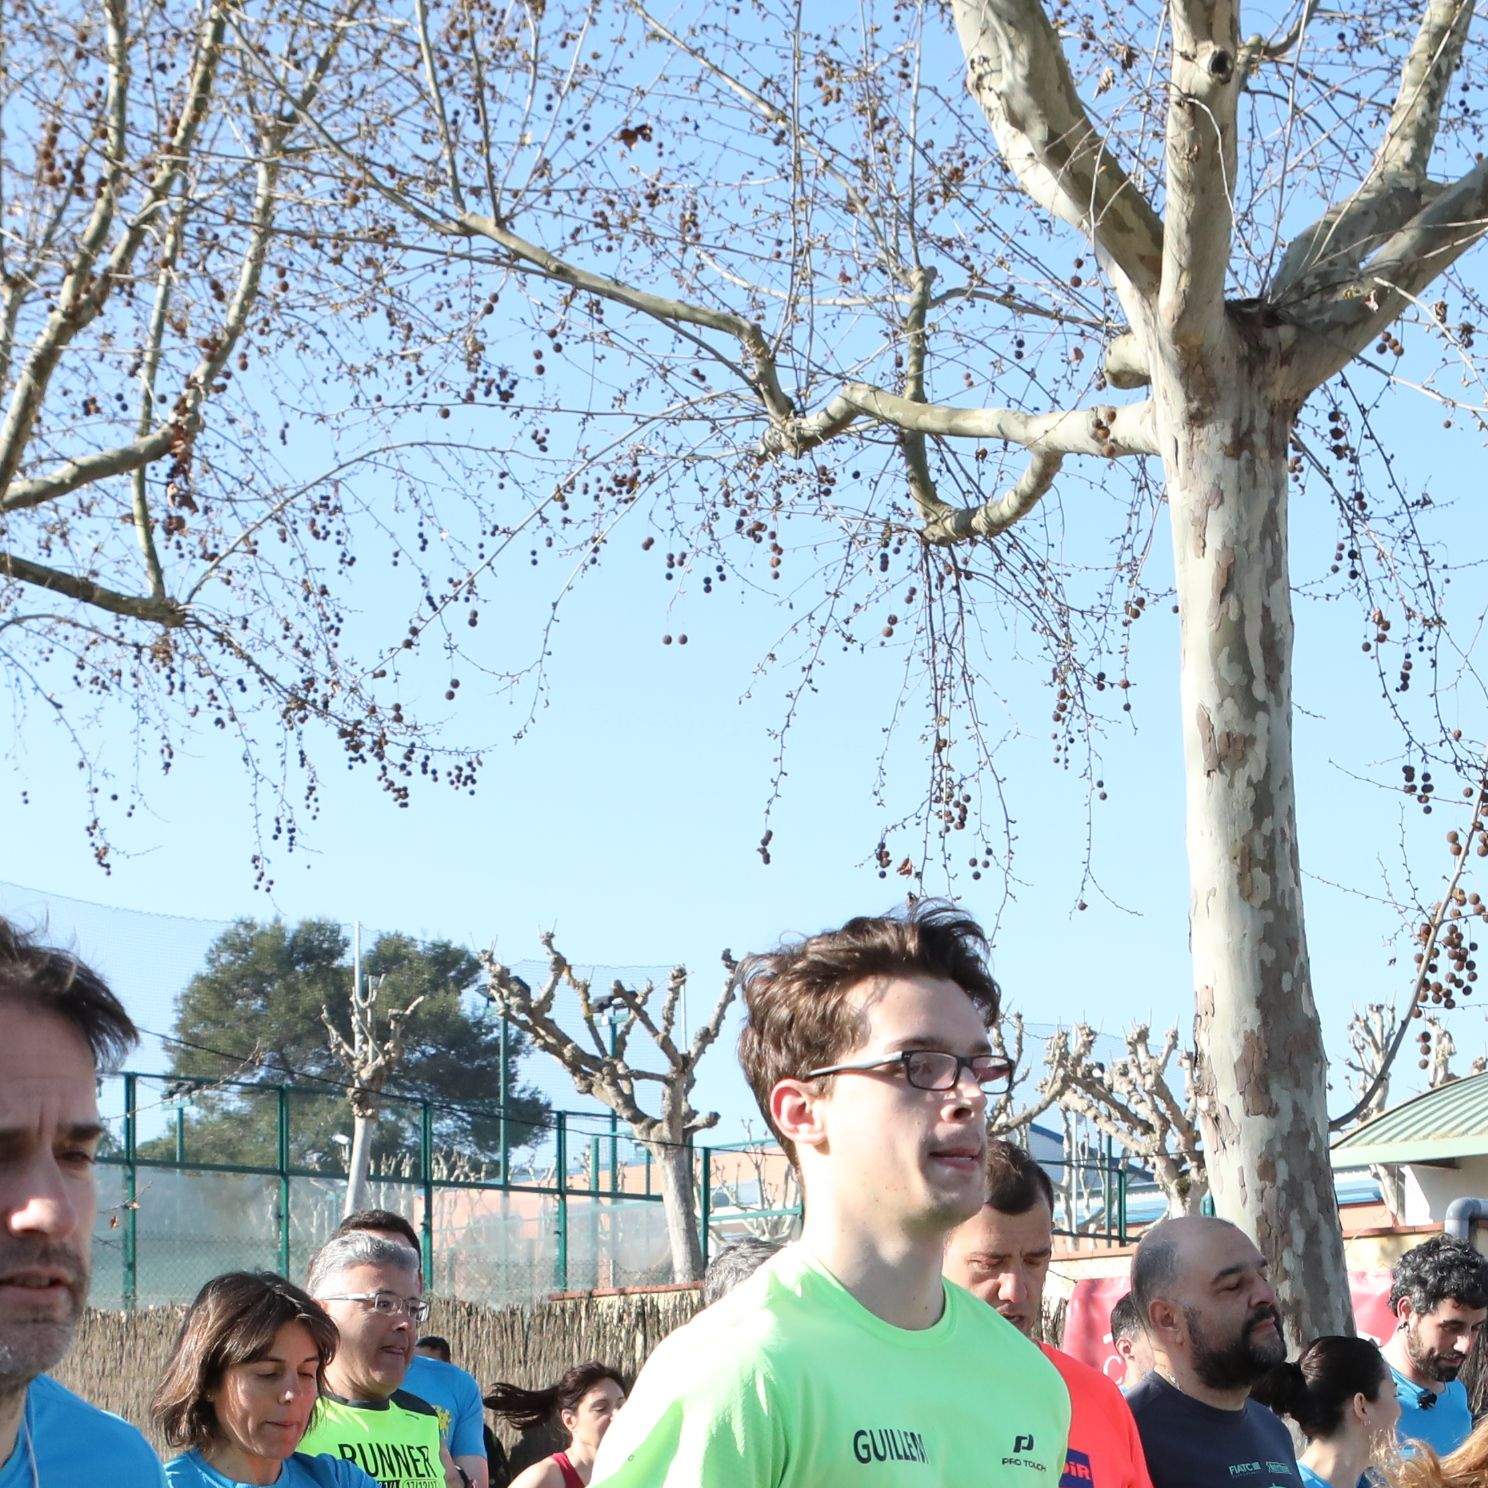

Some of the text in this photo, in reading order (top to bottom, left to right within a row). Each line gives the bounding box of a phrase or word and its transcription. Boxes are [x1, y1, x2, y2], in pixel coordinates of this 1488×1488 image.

[337, 1442, 438, 1478] RUNNER
[1002, 1457, 1047, 1473] PRO TOUCH
[1228, 1463, 1254, 1476] FIATC
